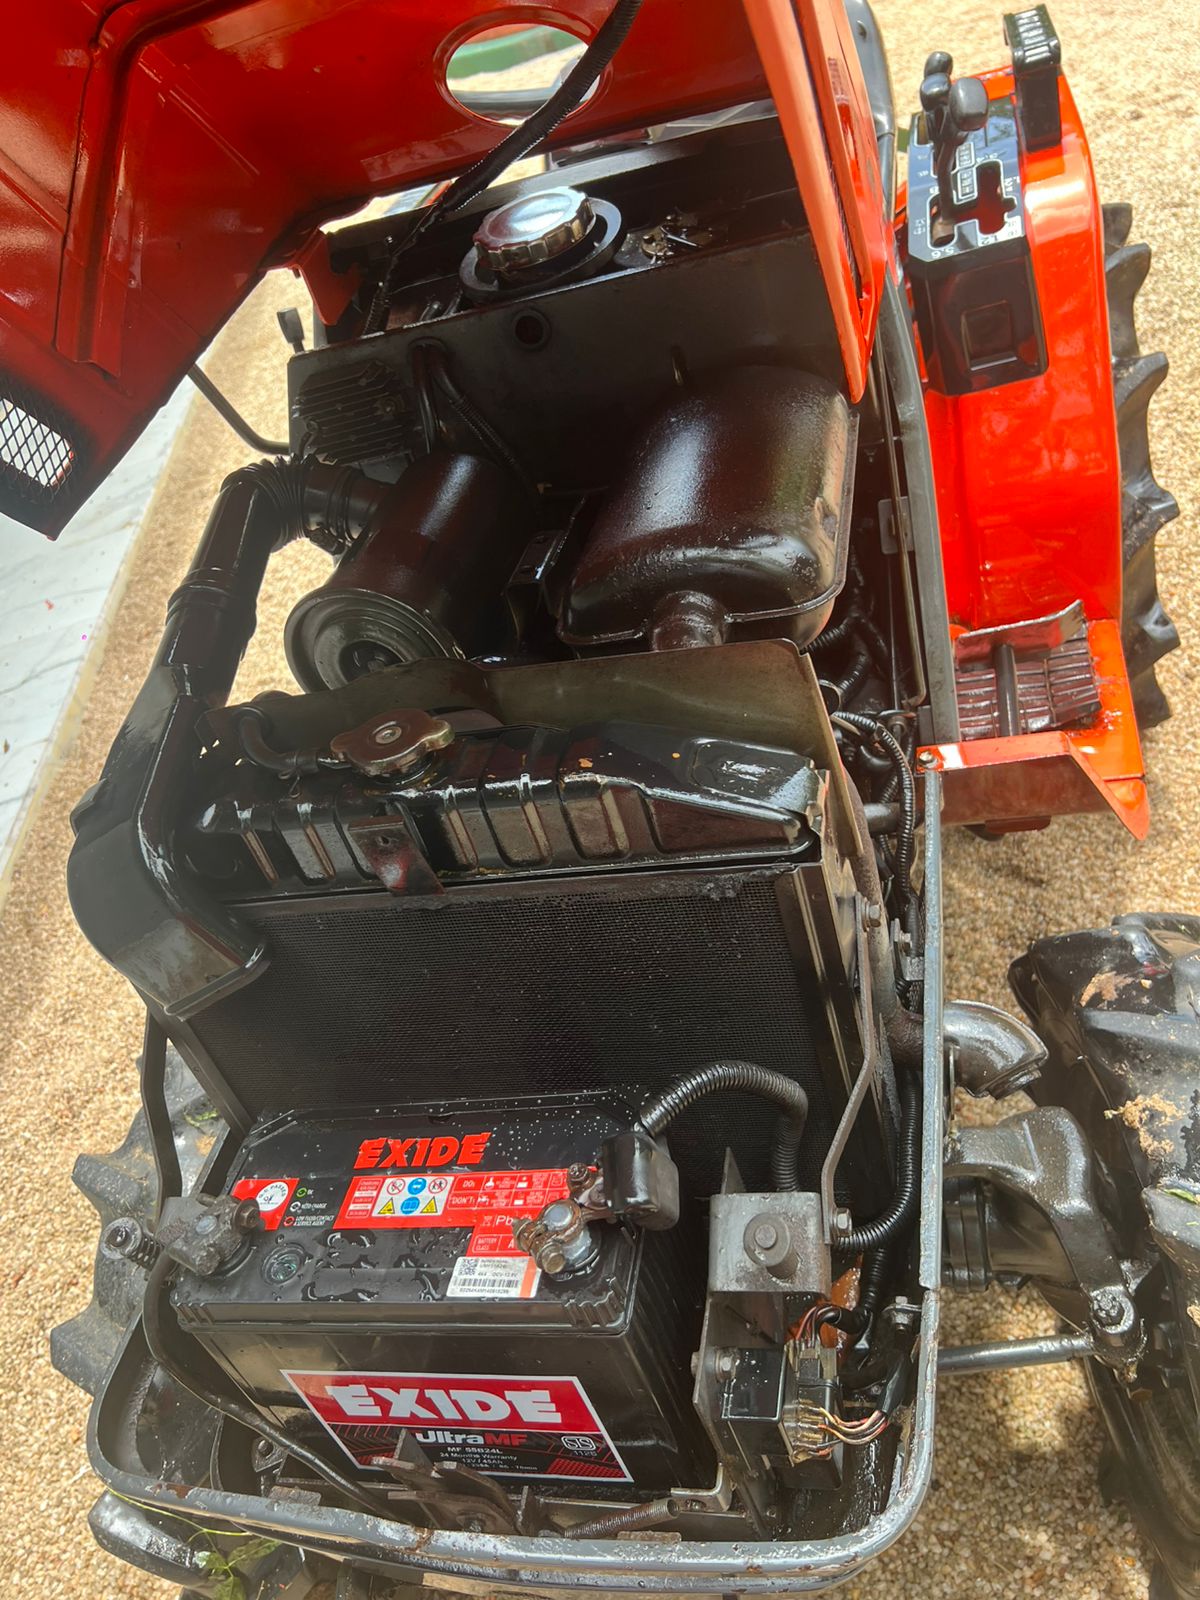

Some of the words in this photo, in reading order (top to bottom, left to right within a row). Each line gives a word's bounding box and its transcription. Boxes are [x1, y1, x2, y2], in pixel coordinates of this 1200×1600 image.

[354, 1132, 492, 1169] EXIDE
[496, 1215, 514, 1226] Pb
[325, 1384, 562, 1423] EXIDE
[482, 1453, 518, 1461] Warranty
